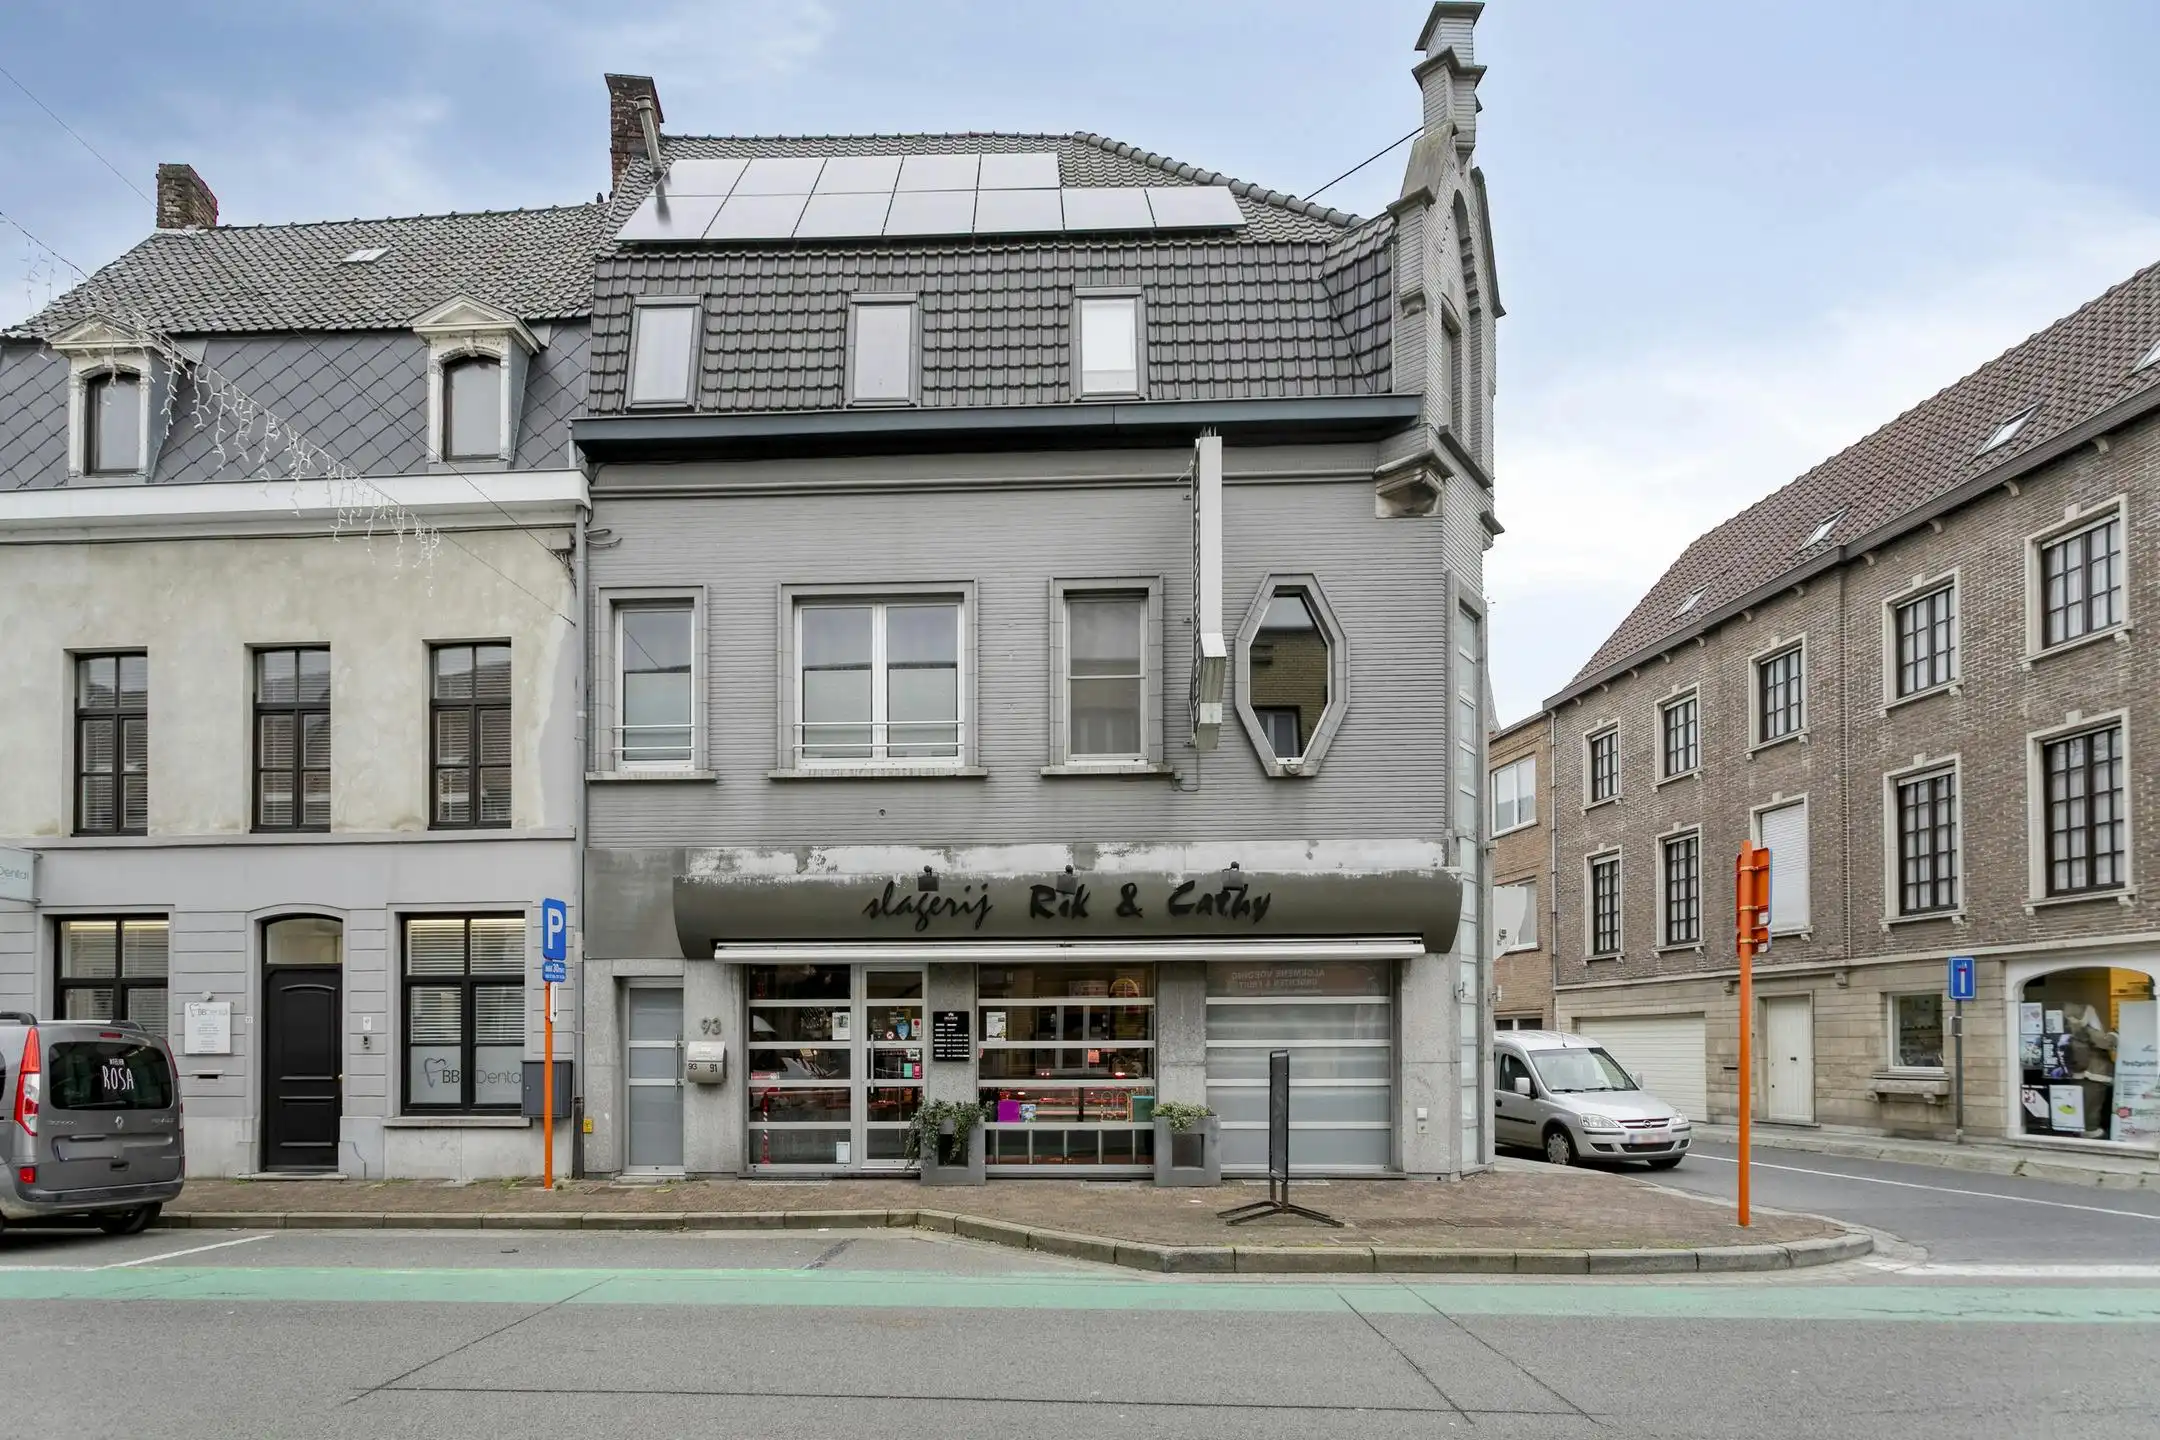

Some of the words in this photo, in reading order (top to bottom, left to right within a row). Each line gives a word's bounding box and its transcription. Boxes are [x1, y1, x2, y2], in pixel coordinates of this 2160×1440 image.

[862, 880, 993, 932] slagerij
[1029, 884, 1090, 920] Rik
[1116, 882, 1143, 919] &
[1168, 880, 1271, 925] Cathy
[547, 907, 564, 950] P
[701, 1018, 722, 1036] 93
[688, 1062, 698, 1071] 93
[709, 1063, 718, 1073] 91
[102, 1065, 134, 1090] ROSA
[475, 1069, 521, 1085] Denta
